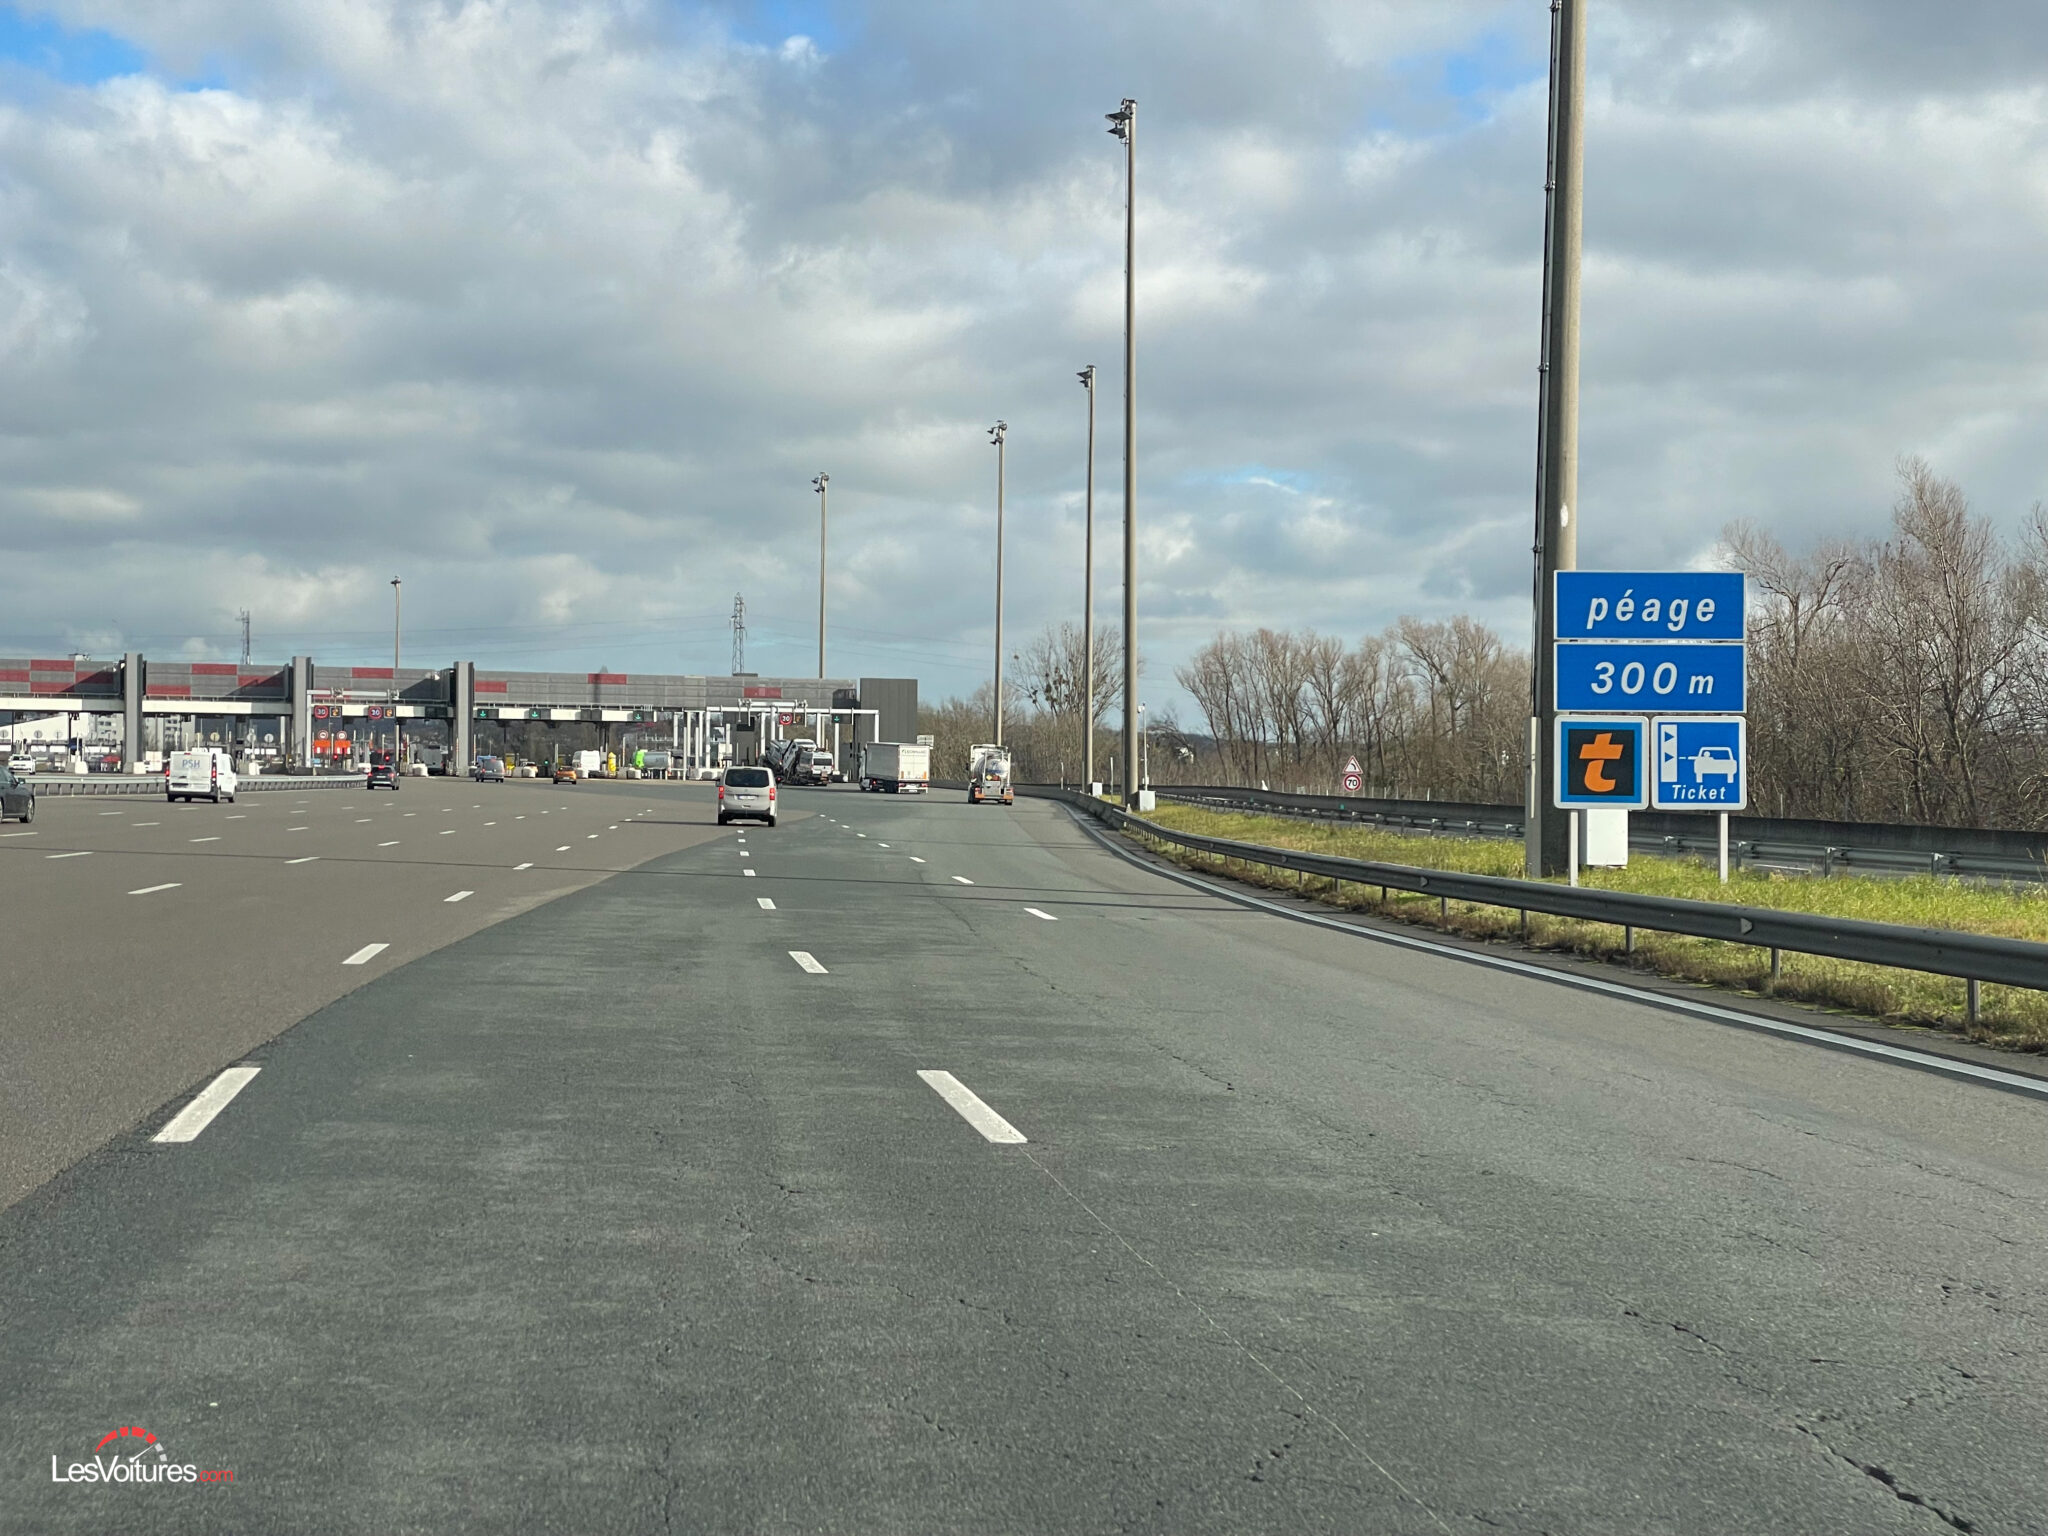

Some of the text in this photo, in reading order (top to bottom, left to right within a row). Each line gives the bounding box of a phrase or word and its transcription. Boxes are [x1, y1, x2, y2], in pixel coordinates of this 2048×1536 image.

[1586, 589, 1716, 632] péage
[1590, 661, 1714, 695] 300 m
[182, 759, 200, 768] PSH
[1347, 779, 1358, 787] 70
[1671, 784, 1726, 800] Ticket
